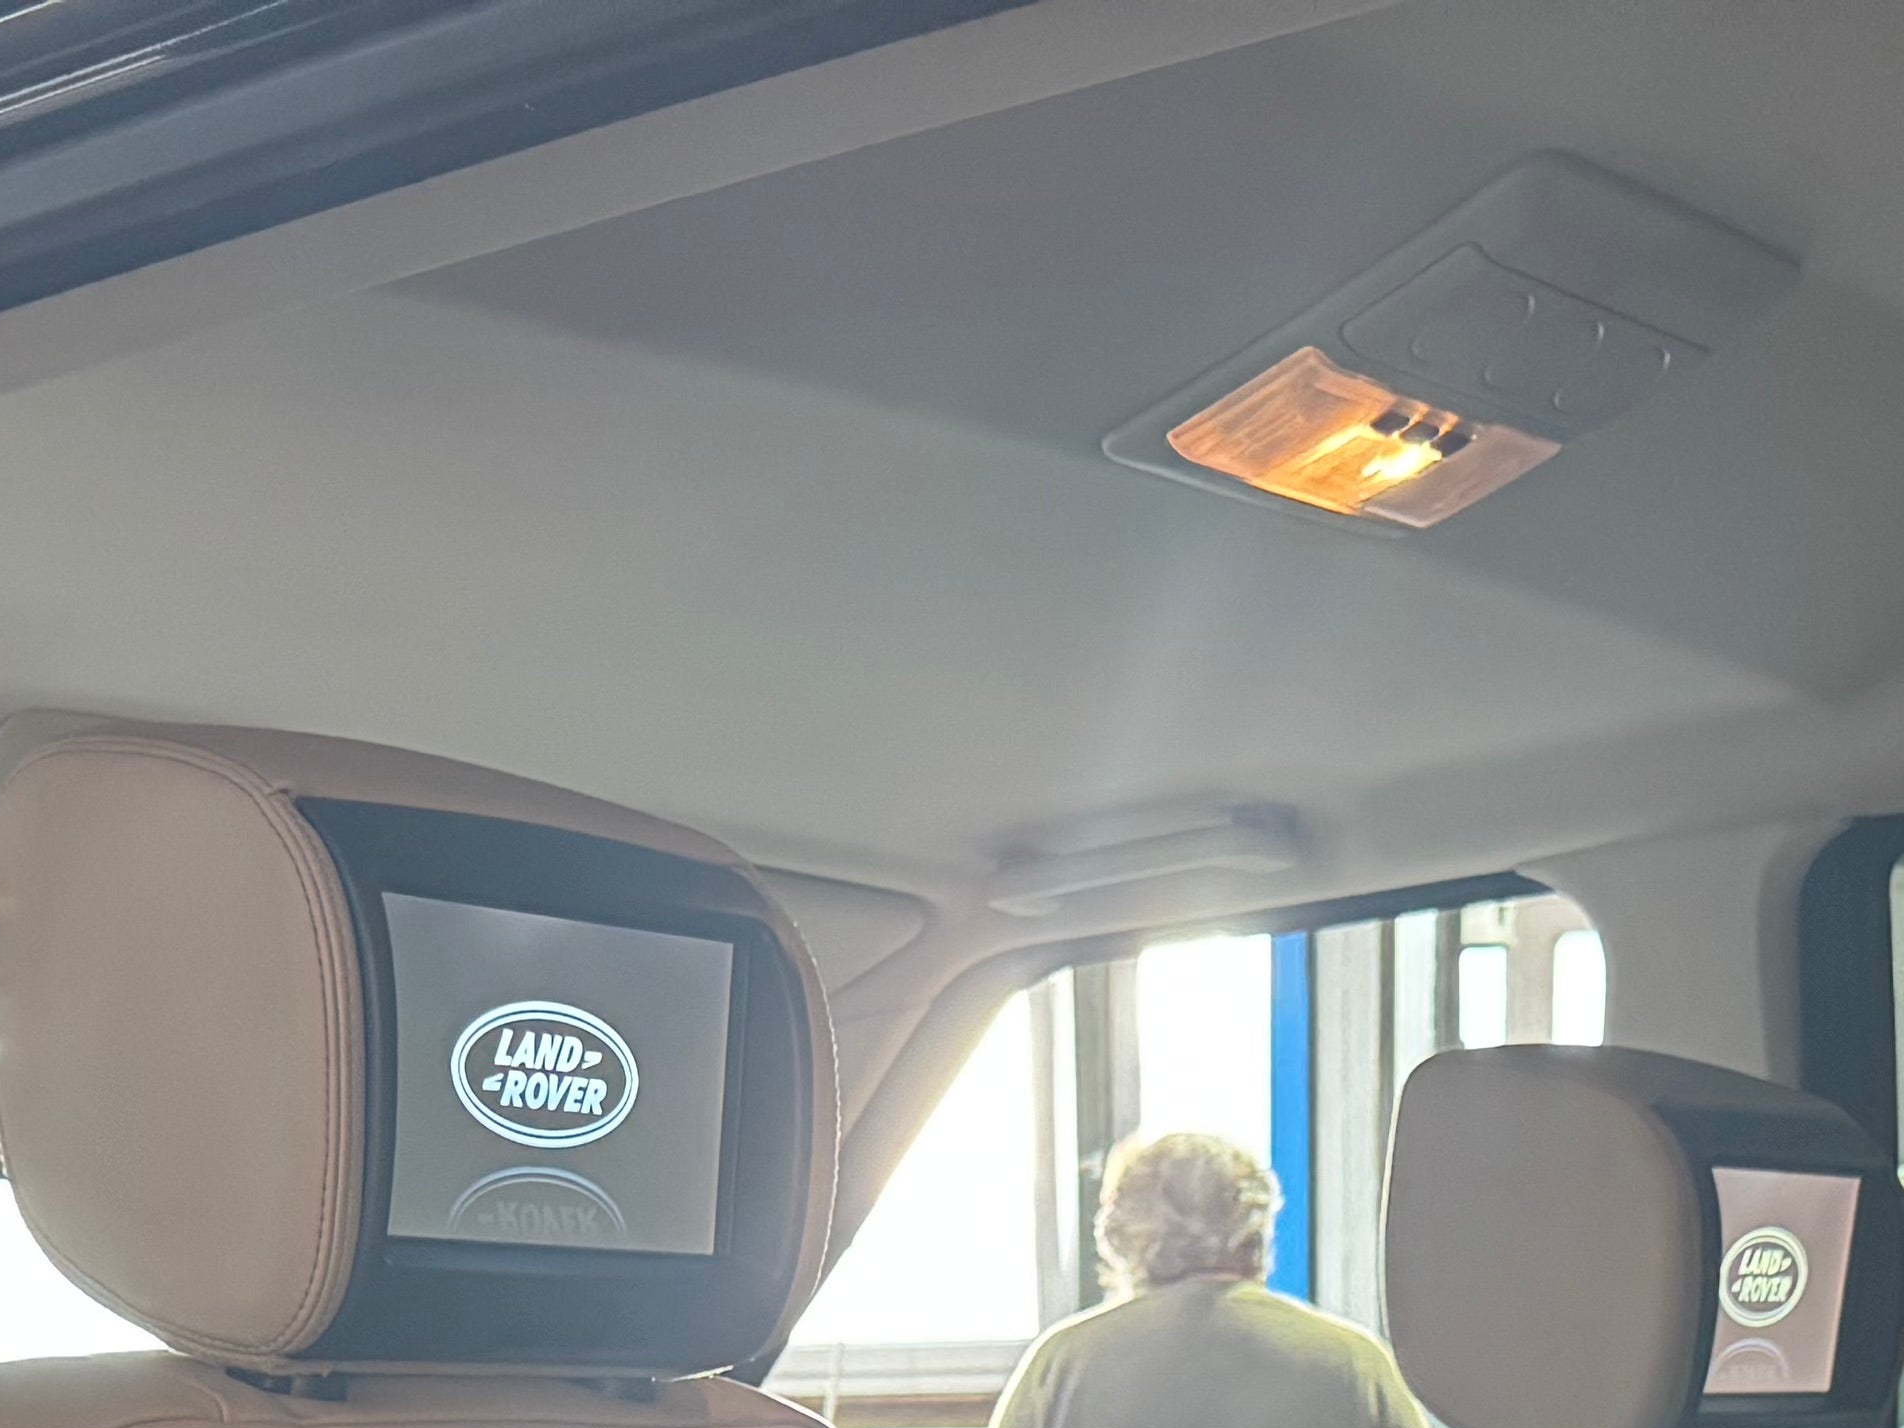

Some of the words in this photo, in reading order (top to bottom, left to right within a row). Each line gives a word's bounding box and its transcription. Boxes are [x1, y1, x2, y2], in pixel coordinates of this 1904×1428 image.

[493, 1027, 584, 1073] LAND
[499, 1069, 608, 1116] ROVER
[1738, 1247, 1785, 1276] LAND
[1738, 1275, 1793, 1303] ROVER
